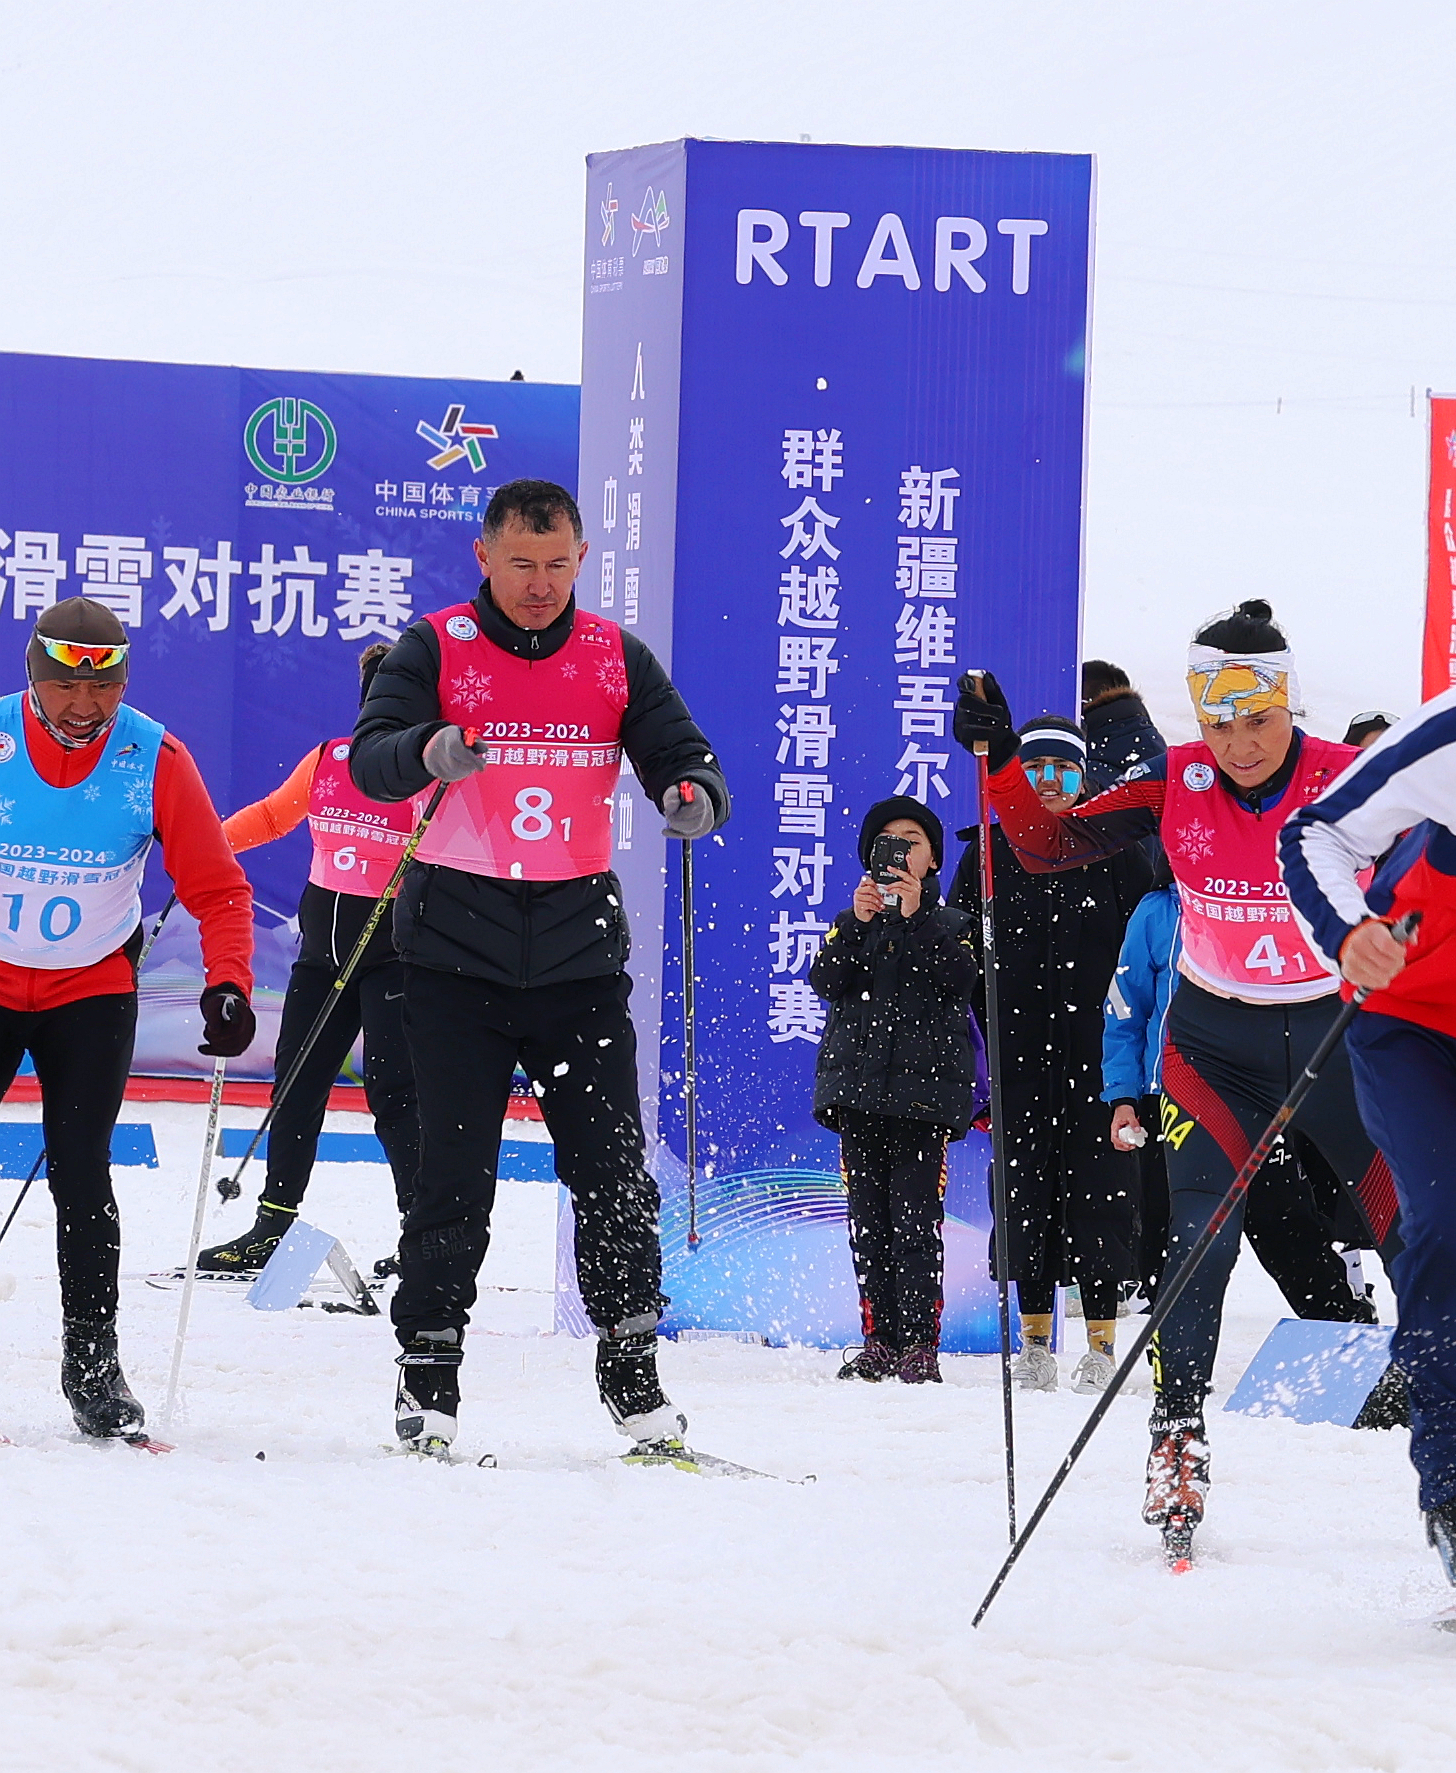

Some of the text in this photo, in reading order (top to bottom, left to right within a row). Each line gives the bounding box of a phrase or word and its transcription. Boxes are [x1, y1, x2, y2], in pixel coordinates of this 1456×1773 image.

[735, 209, 1049, 294] RTART
[375, 505, 417, 519] CHINA
[419, 508, 474, 523] SPORTS
[0, 528, 415, 641] 滑雪对抗赛
[893, 466, 961, 803] 新疆维吾尔
[482, 722, 590, 740] 2023-2024
[766, 428, 844, 1046] 群众越野滑雪对抗赛
[320, 805, 389, 827] 2023-2024
[0, 843, 107, 865] 2023-2024
[1203, 876, 1287, 897] 2023-20
[2, 893, 82, 942] 10
